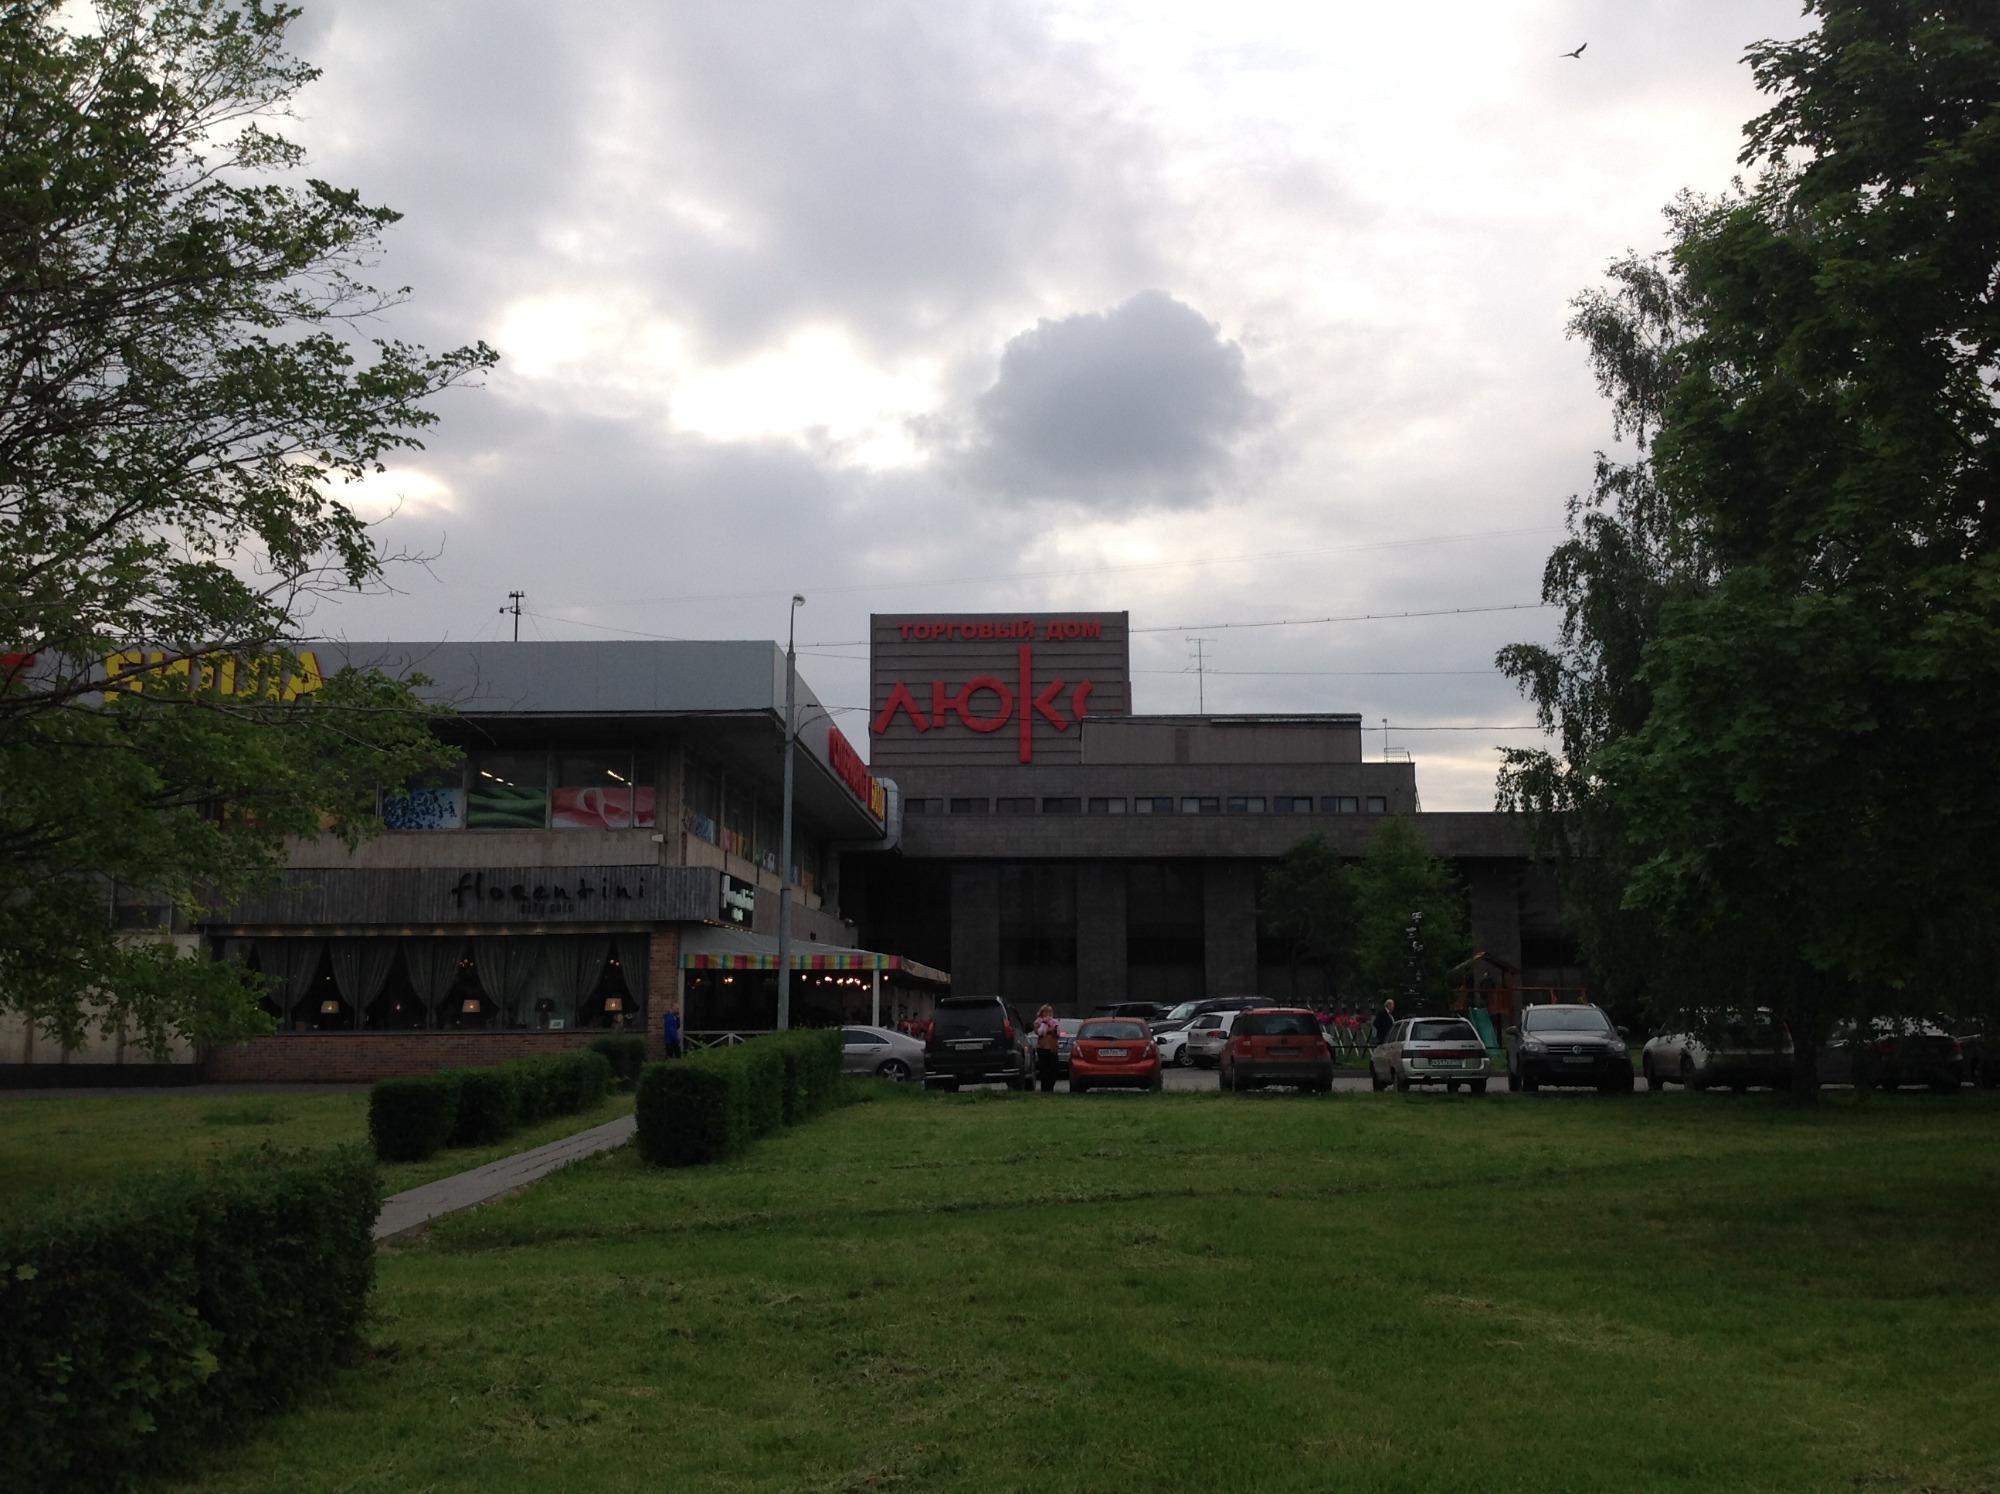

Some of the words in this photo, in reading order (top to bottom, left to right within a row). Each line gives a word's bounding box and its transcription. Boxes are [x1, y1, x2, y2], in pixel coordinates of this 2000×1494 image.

[897, 621, 1036, 641] ТОРГОВЫЙ
[1046, 621, 1102, 640] ДОМ
[870, 644, 1094, 764] ЛЮКС
